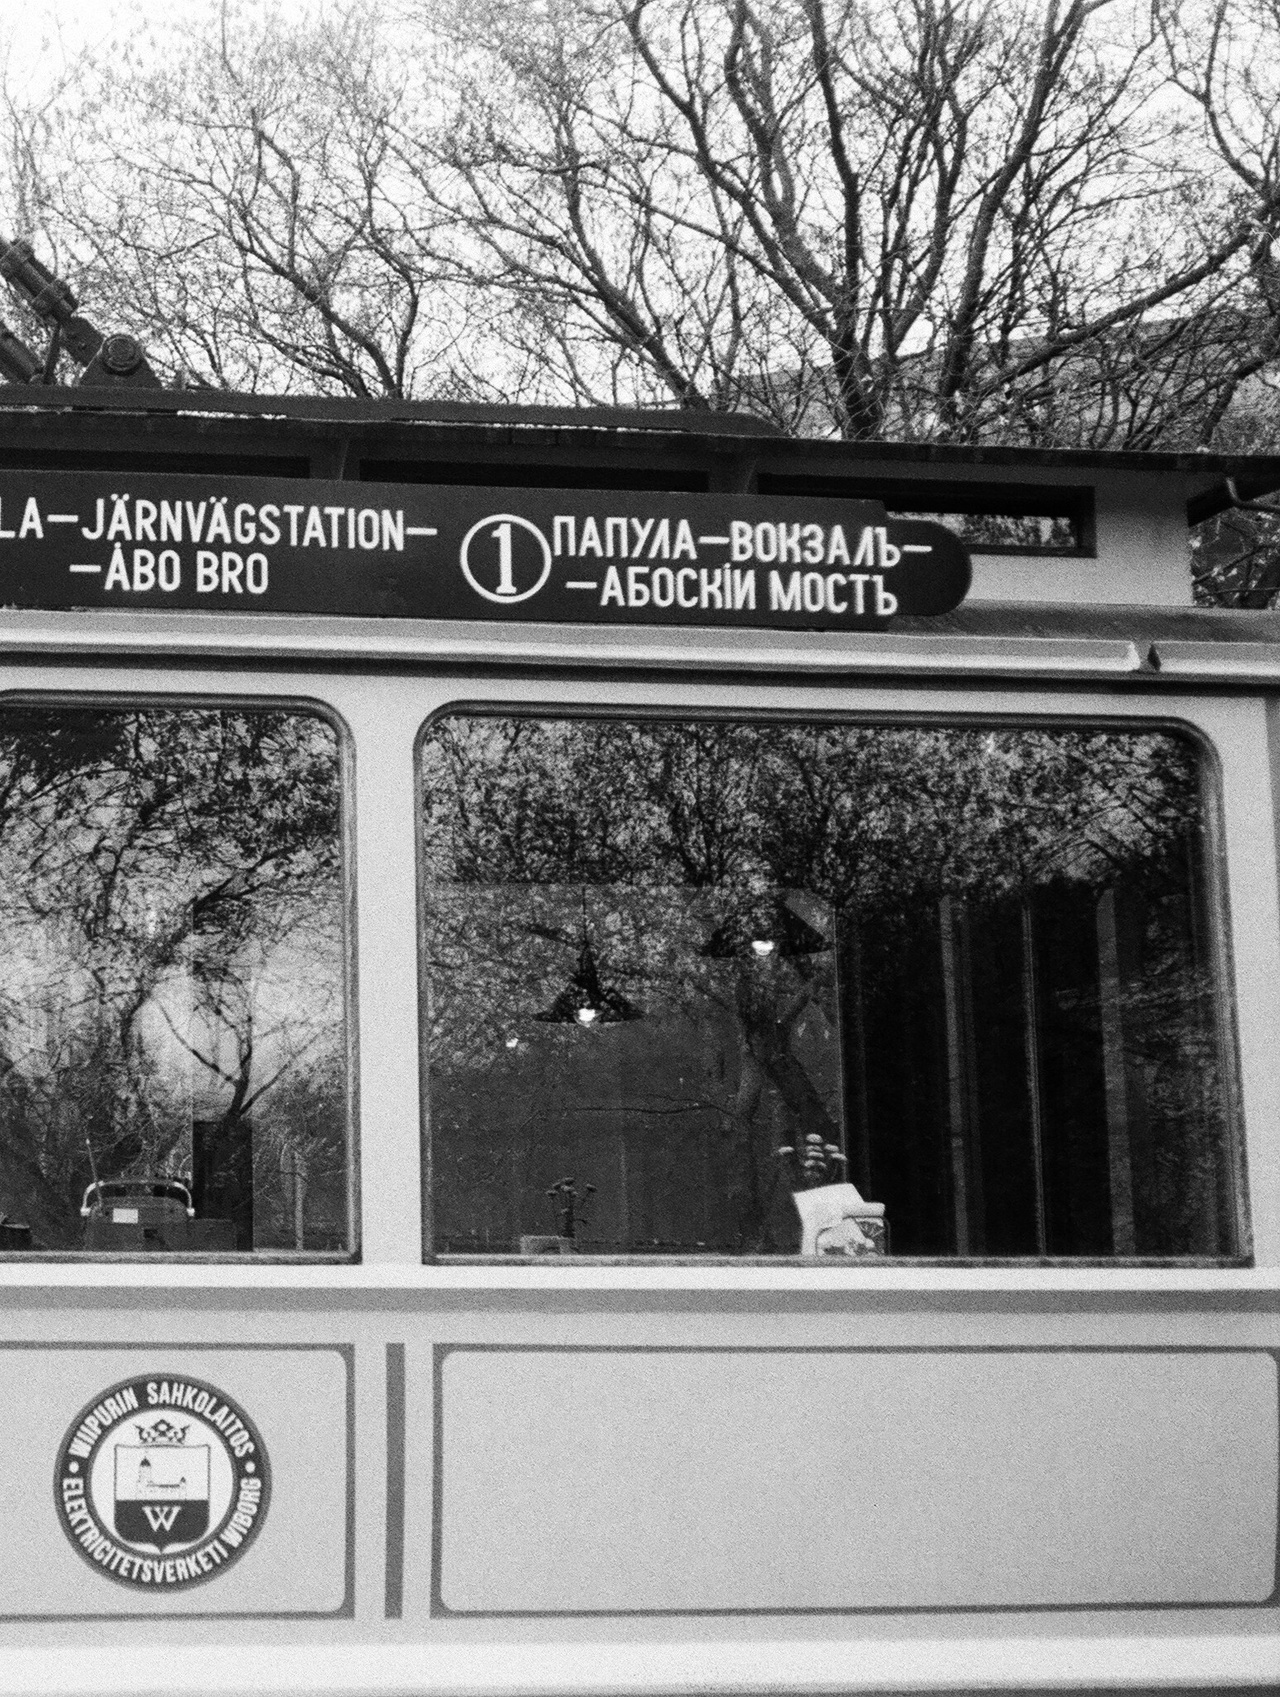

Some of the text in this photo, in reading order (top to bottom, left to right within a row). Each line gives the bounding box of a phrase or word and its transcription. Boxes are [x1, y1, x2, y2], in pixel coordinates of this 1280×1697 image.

[196, 550, 269, 594] BRO
[491, 522, 517, 594] 1
[769, 569, 898, 616] МОСТЪ
[141, 1505, 182, 1532] W
[219, 1477, 262, 1549] WIBORG
